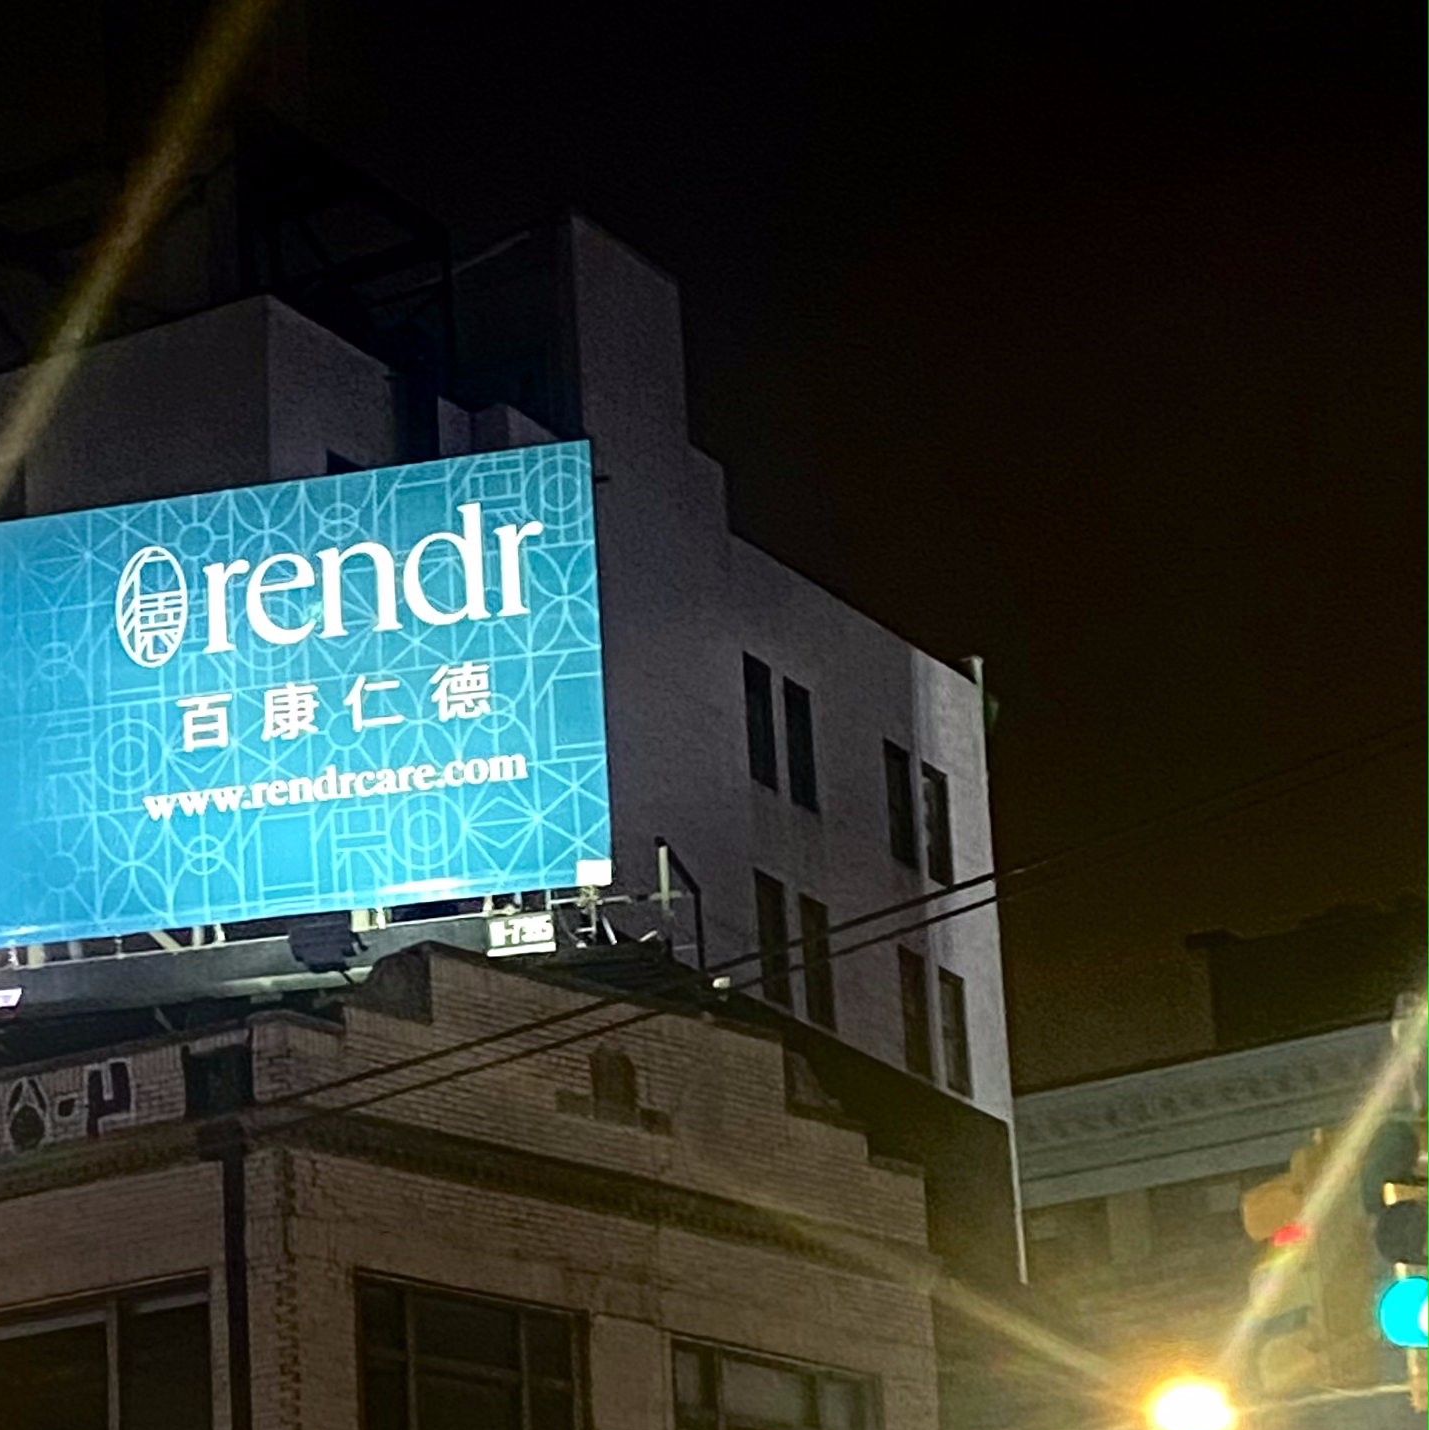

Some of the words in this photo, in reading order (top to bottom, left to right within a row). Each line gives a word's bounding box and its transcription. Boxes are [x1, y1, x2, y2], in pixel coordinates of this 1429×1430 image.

[203, 502, 543, 654] rendr
[176, 662, 491, 753] 百康仁德
[142, 754, 528, 822] www.rendrcare.com
